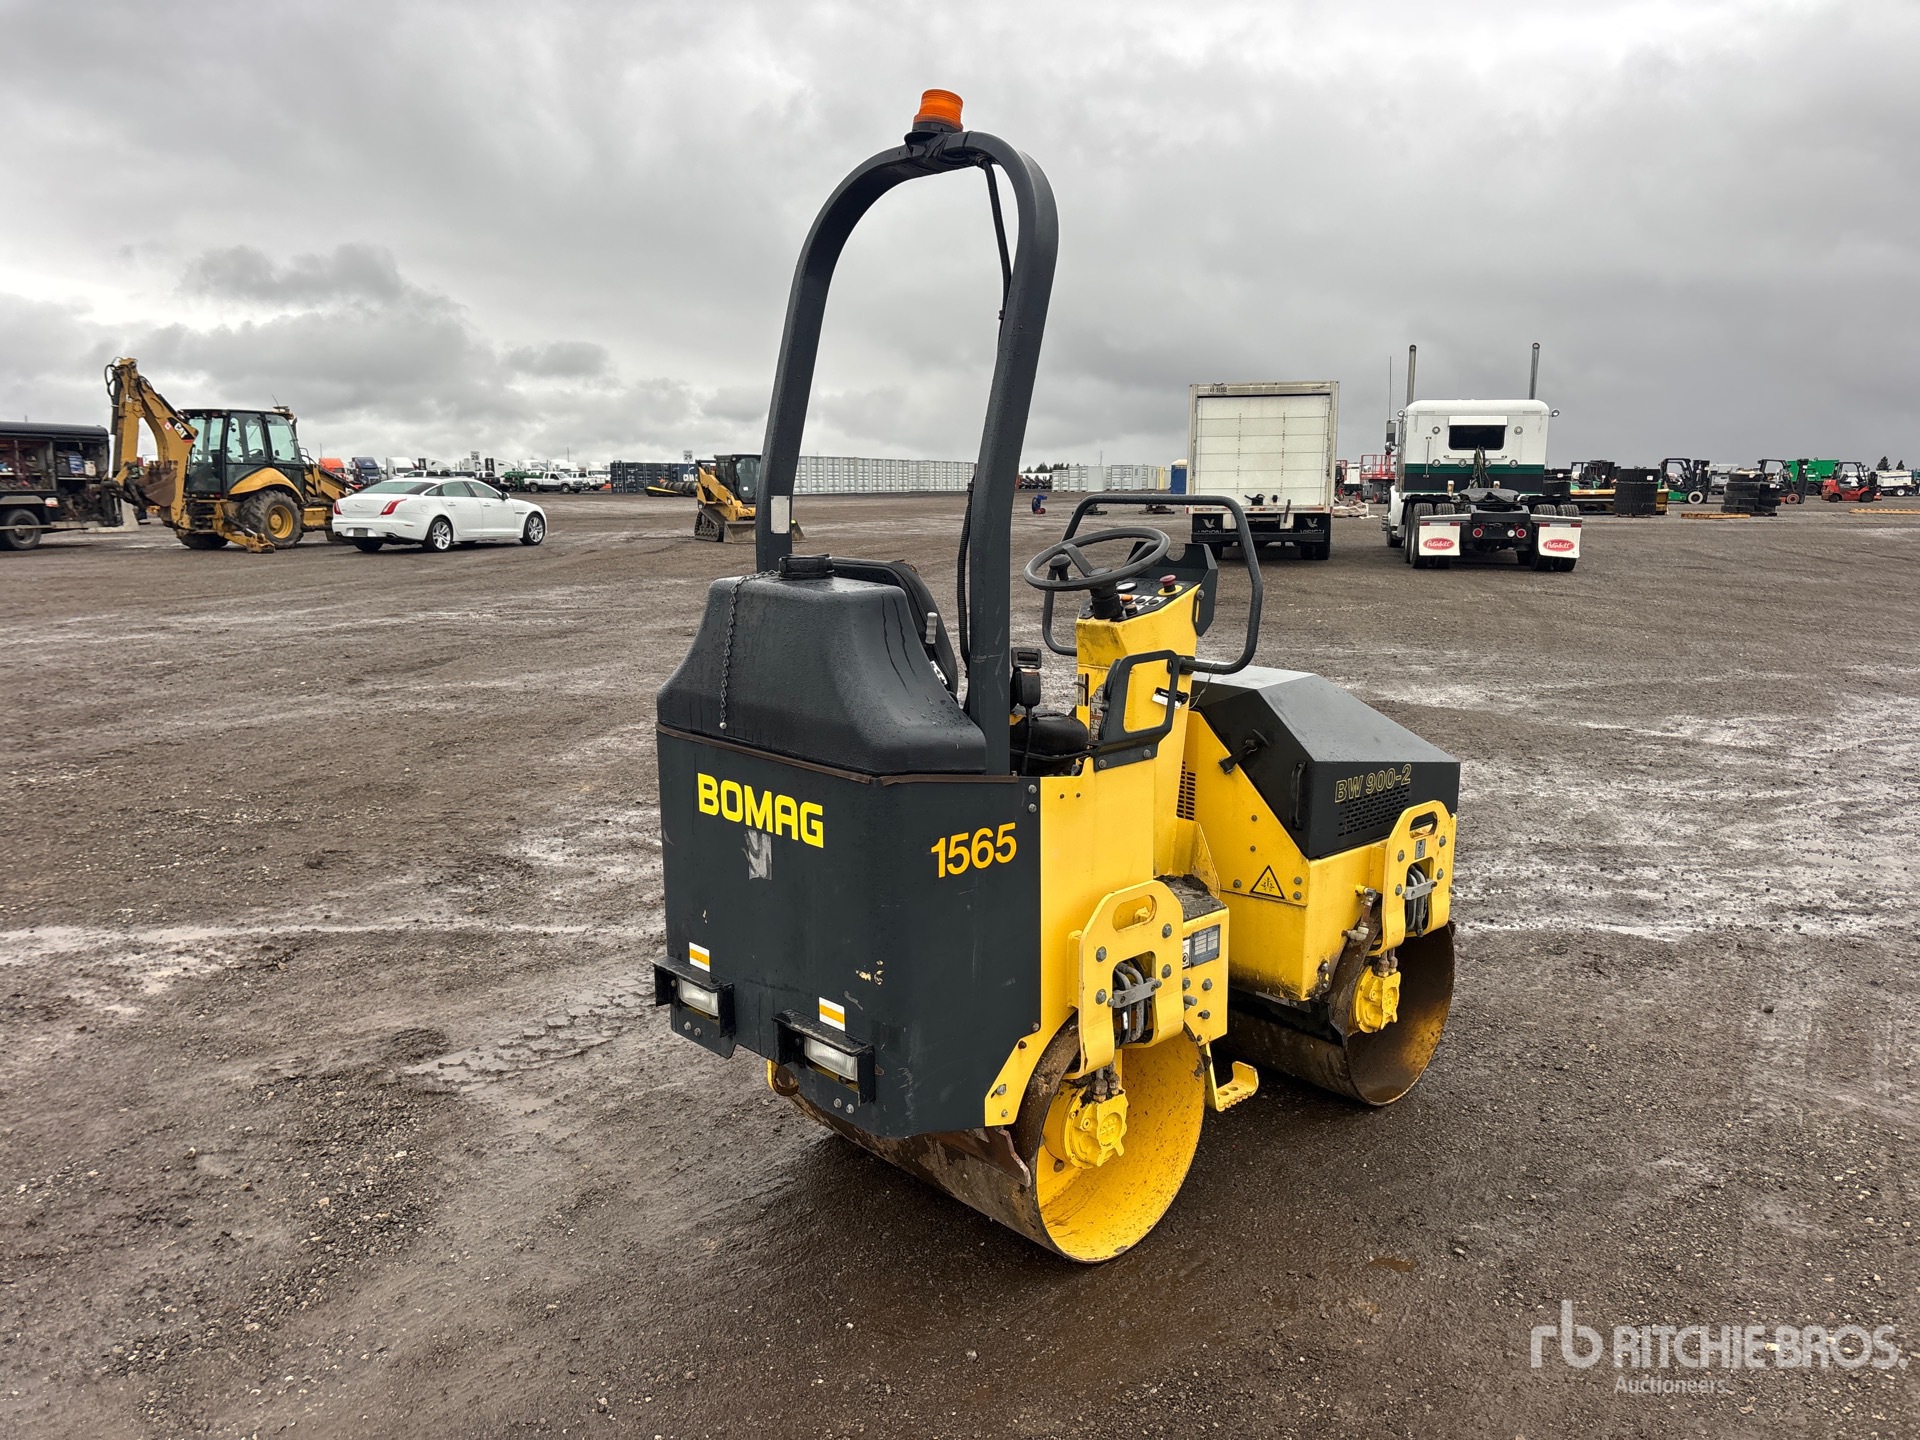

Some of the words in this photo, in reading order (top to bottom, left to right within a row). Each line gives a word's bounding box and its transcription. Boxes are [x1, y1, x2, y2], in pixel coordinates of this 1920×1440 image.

[174, 423, 188, 438] CAT
[1335, 774, 1364, 803] BW
[1365, 763, 1412, 795] 900-2
[697, 772, 824, 849] BOMAG
[930, 822, 1017, 878] 1565
